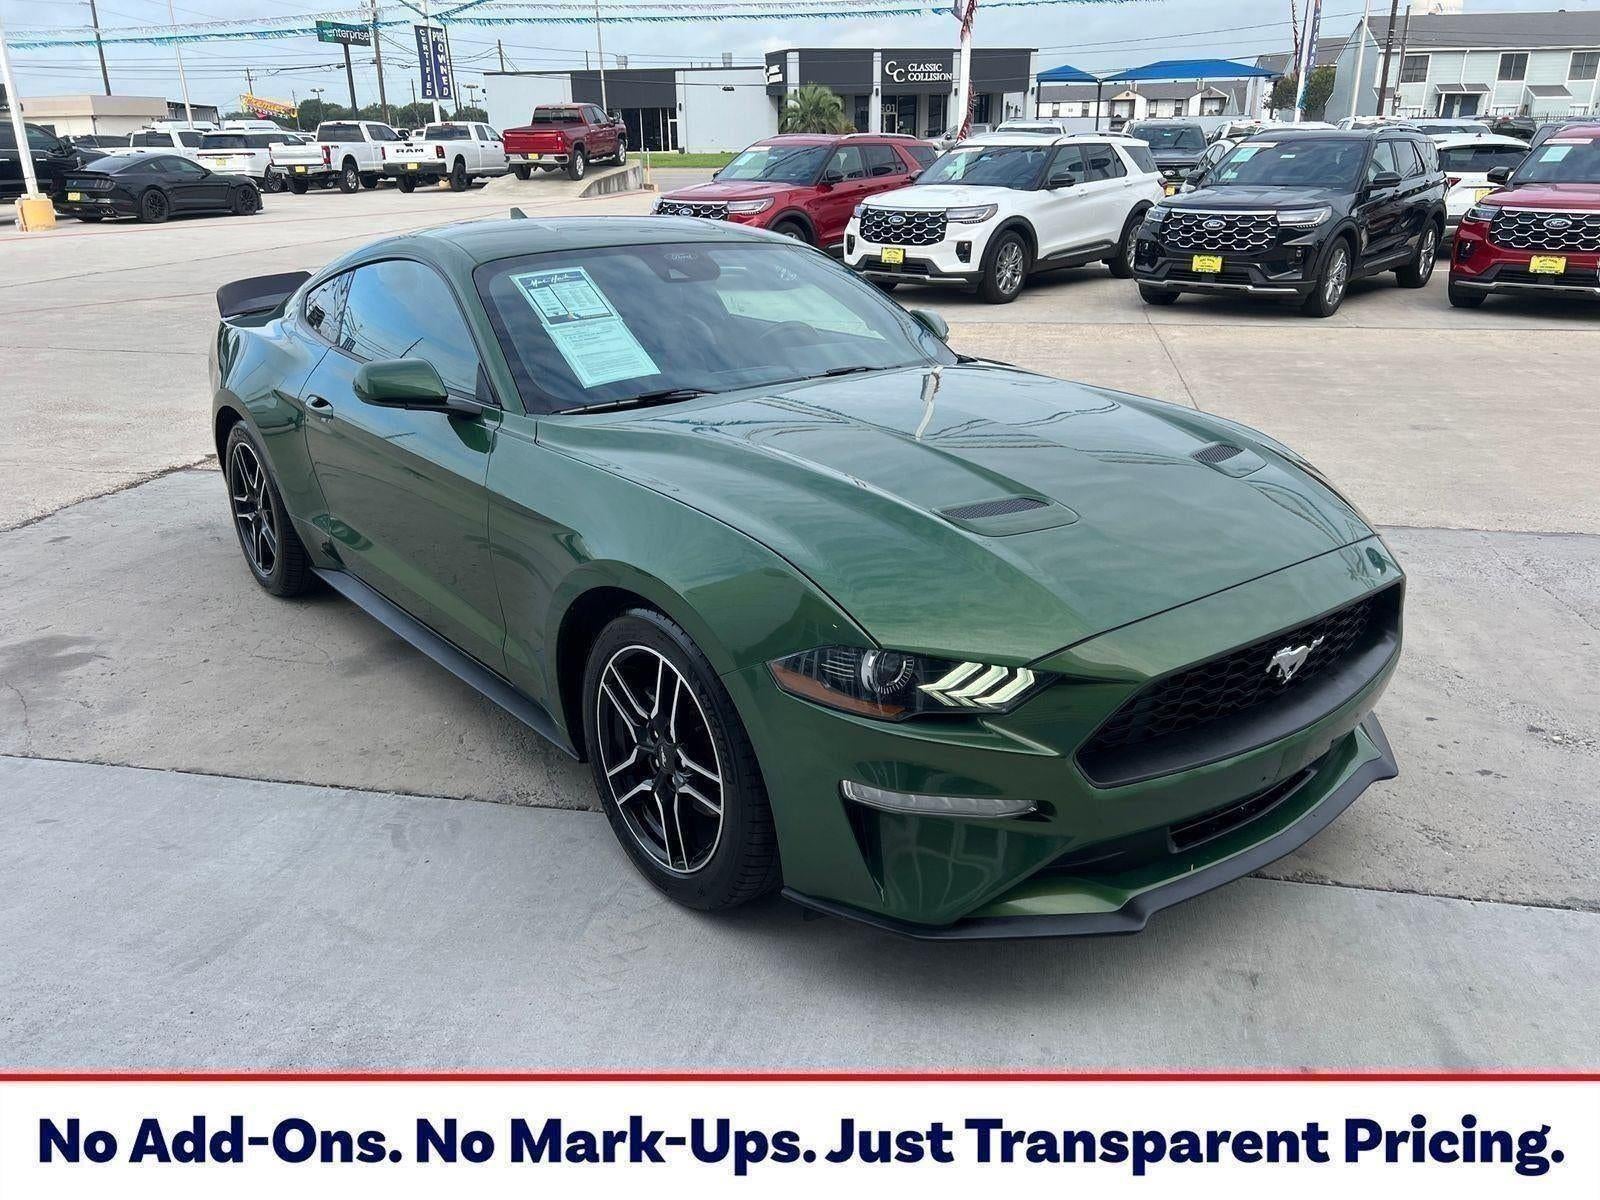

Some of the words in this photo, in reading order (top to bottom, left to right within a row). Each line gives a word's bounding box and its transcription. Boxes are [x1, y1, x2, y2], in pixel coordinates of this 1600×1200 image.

[326, 28, 370, 41] enterprise
[420, 29, 433, 96] CERTIFIED
[908, 63, 942, 71] CLASSIC
[437, 43, 449, 96] OWNED
[908, 72, 953, 81] COLLISION
